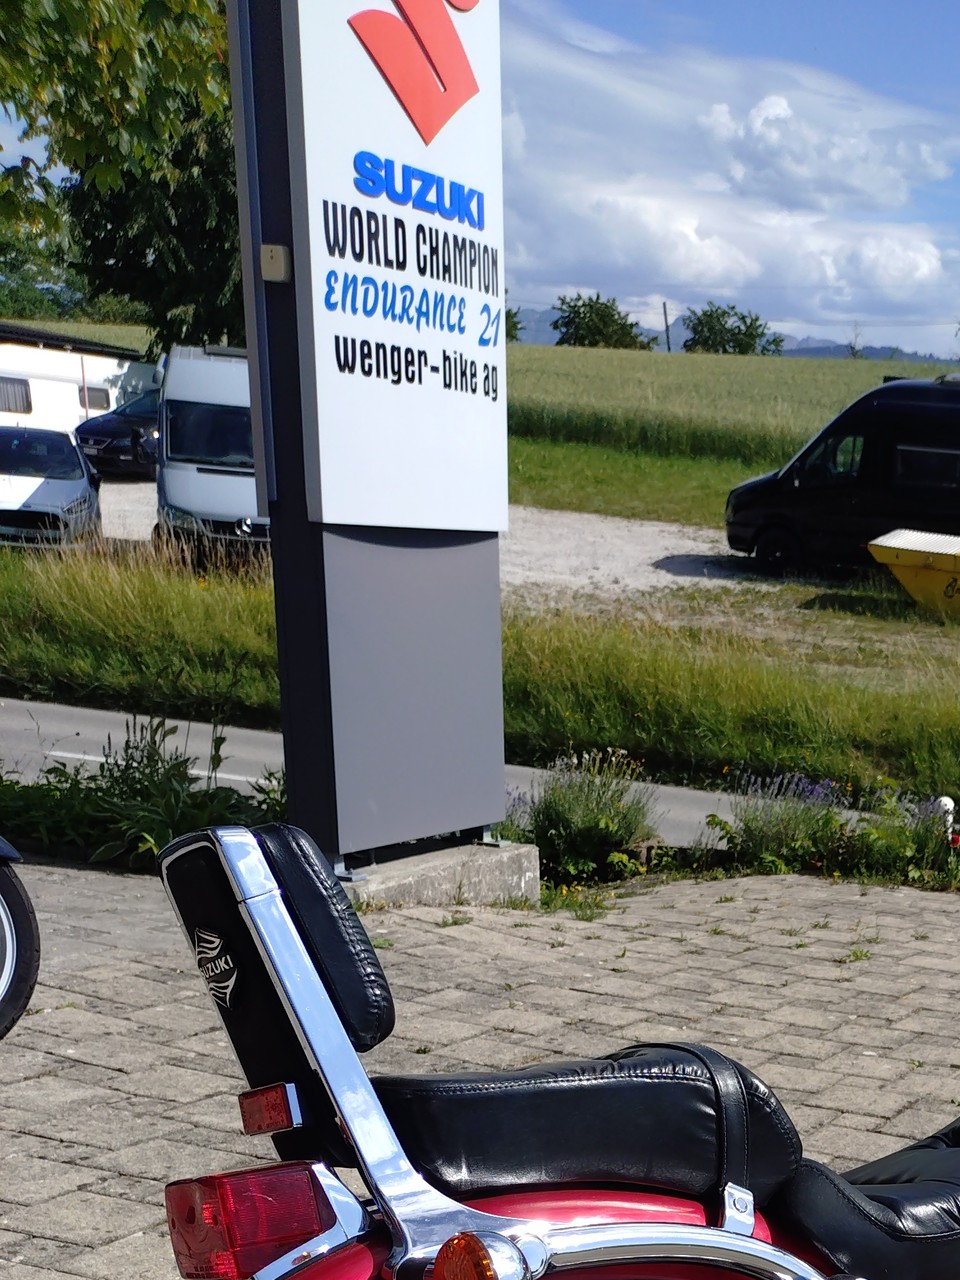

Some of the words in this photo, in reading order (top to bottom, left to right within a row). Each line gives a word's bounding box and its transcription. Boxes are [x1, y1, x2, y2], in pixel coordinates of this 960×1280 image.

[353, 151, 485, 231] SUZUKI
[323, 199, 407, 271] WORLD
[416, 224, 499, 298] CHAMPION
[324, 270, 466, 335] ENDURANCE
[478, 303, 501, 348] 21
[335, 335, 477, 394] wenger-bike
[483, 363, 498, 402] ag
